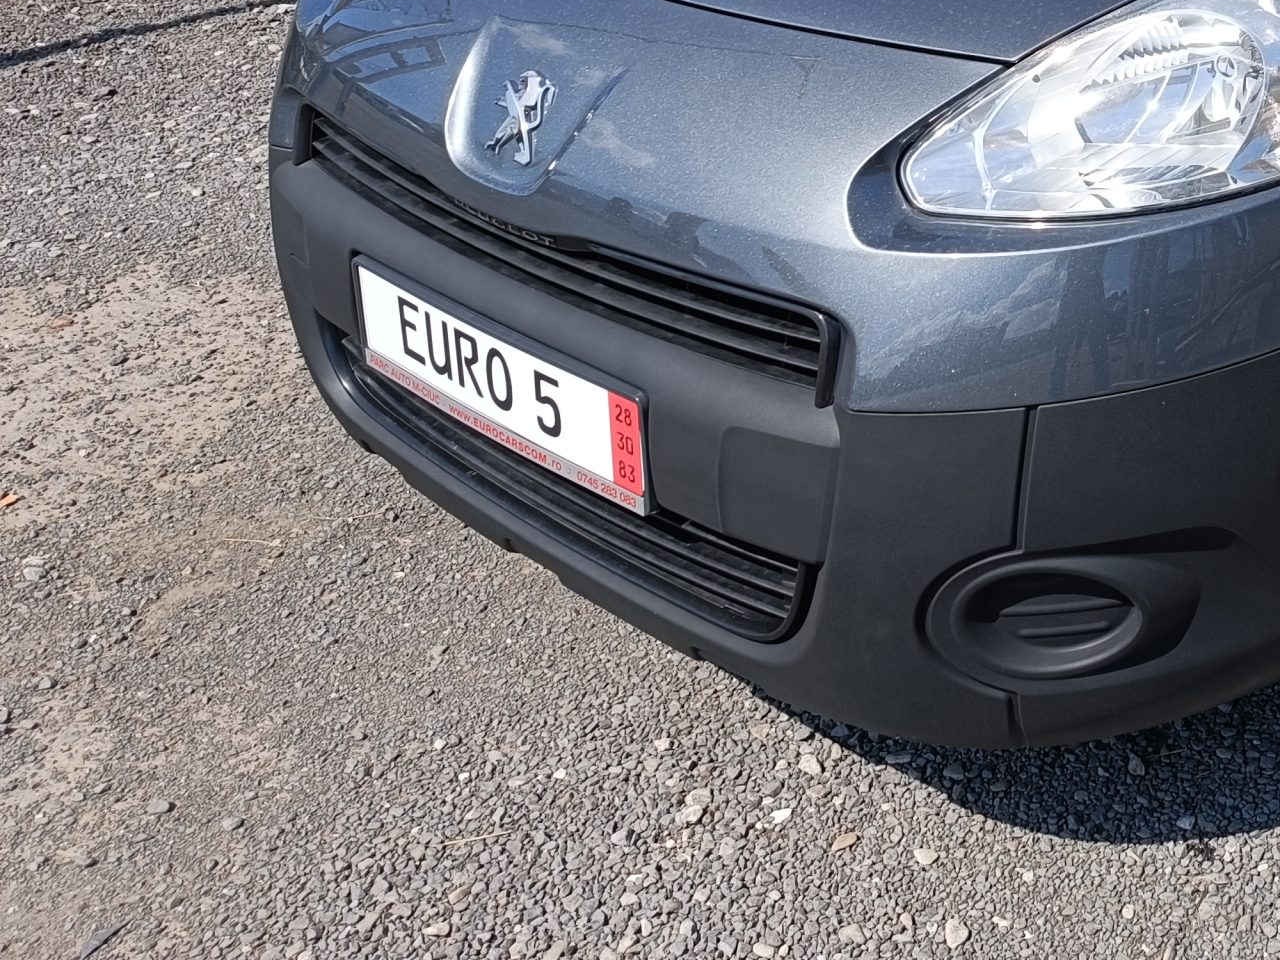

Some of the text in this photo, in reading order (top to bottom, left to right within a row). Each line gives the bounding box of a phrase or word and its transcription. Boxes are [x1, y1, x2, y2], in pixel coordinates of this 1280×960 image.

[397, 295, 562, 438] EURO 5
[614, 403, 632, 427] 28
[370, 354, 390, 374] PARC
[391, 367, 412, 387] AUTO
[411, 380, 441, 406] M-CIUC
[576, 471, 599, 489] 0745
[600, 483, 618, 498] 283
[619, 494, 637, 508] 083
[616, 431, 634, 455] 30
[618, 460, 636, 484] 83
